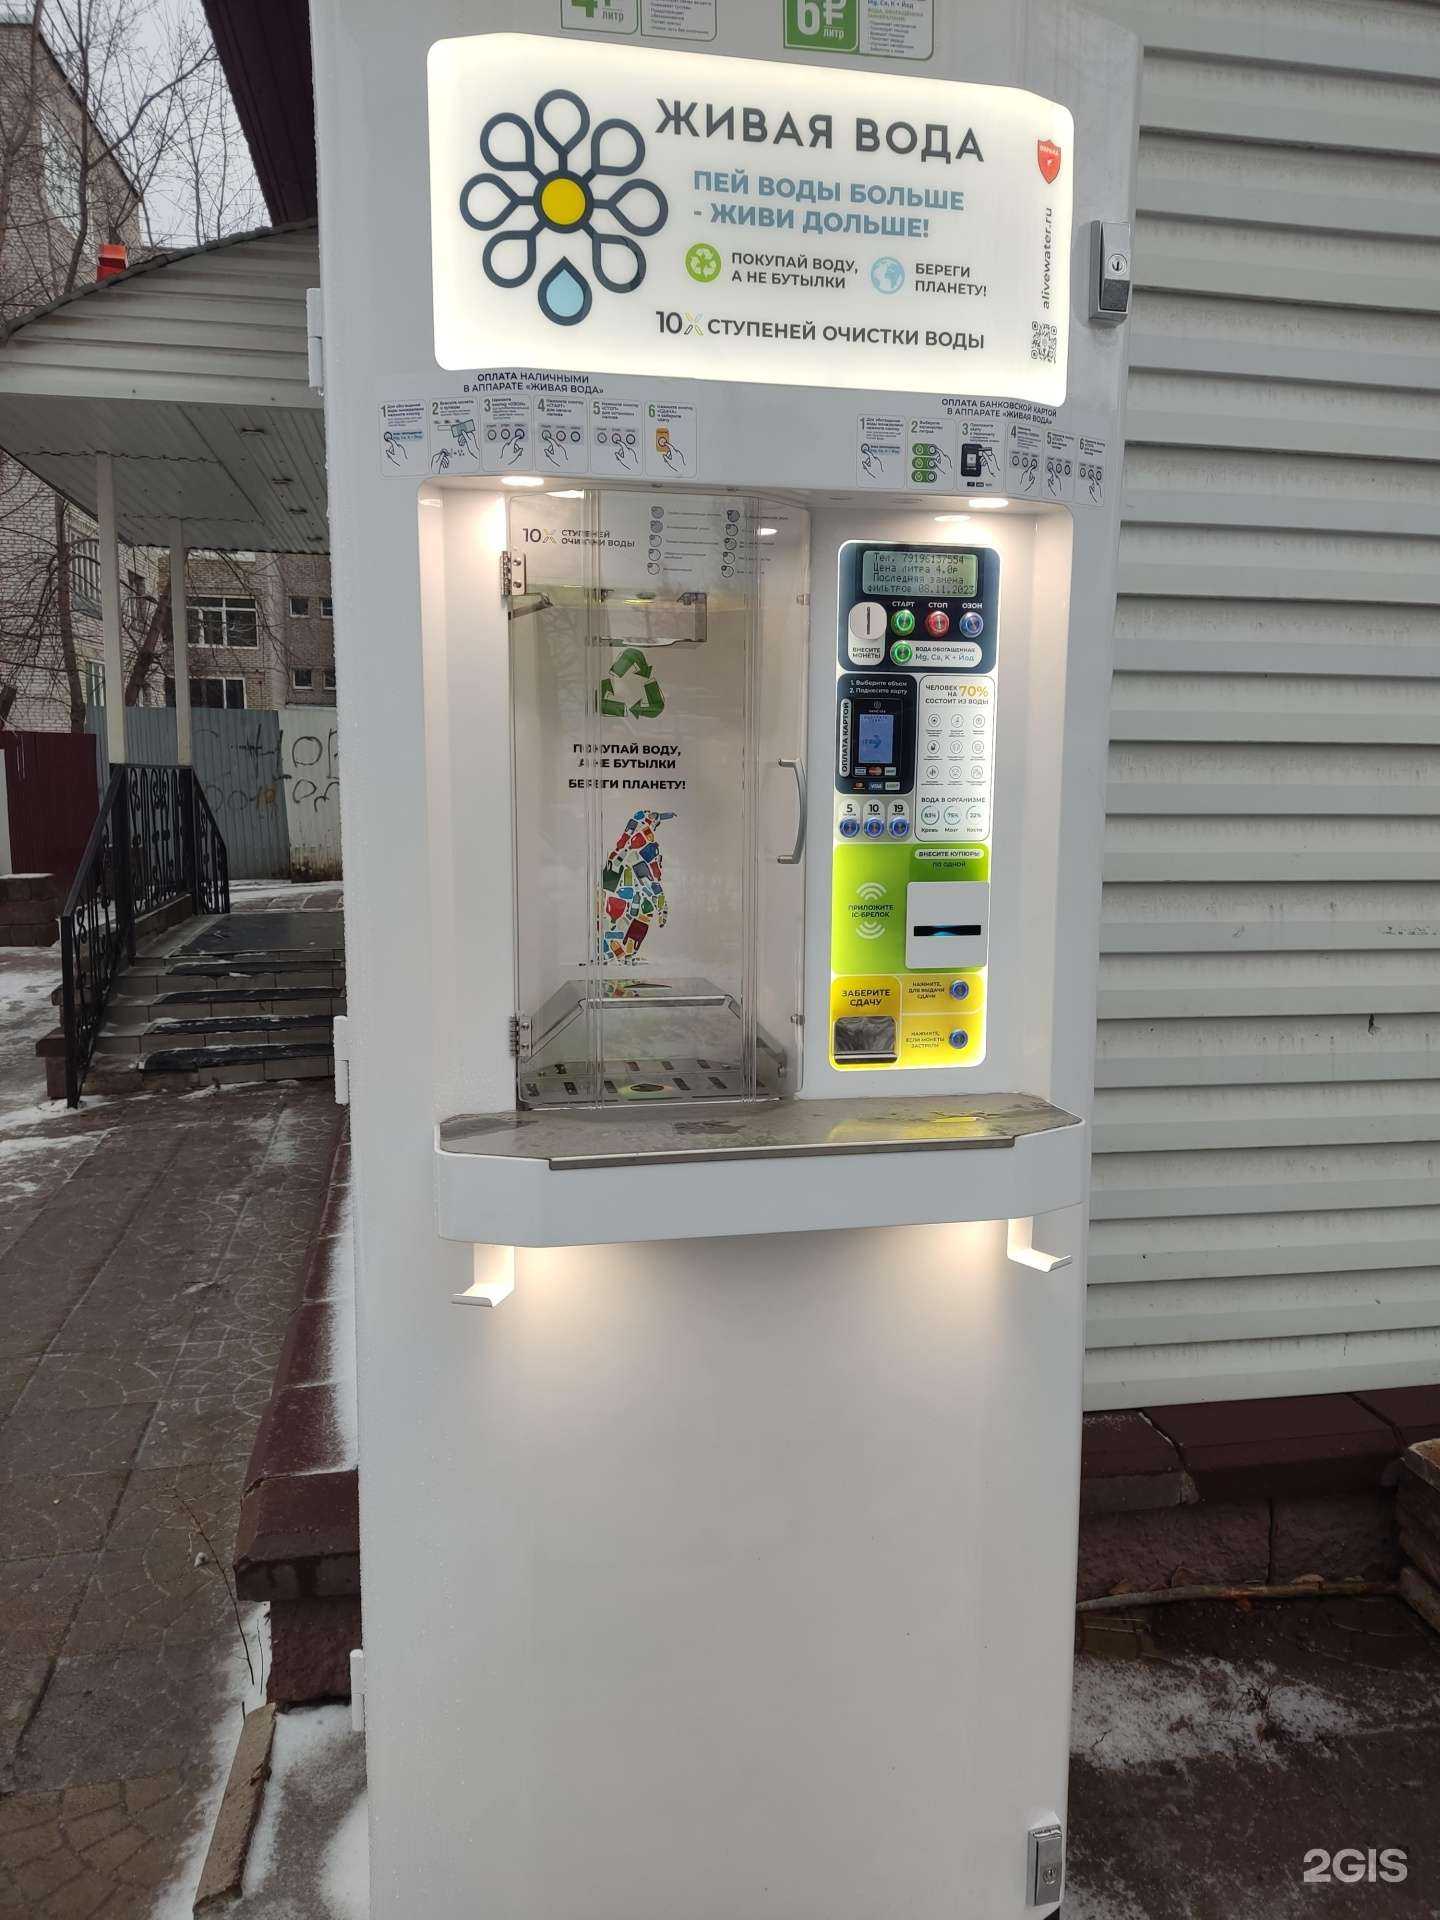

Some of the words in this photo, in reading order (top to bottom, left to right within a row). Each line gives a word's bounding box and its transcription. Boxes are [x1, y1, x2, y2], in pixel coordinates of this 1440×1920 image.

[656, 98, 833, 150] ЖИВАЯ
[855, 115, 984, 163] ВОДА
[692, 170, 752, 196] ПЕЙ
[758, 176, 842, 204] ВОДЫ
[849, 181, 965, 212] БОЛЬШЕ
[710, 203, 796, 231] ЖИВИ
[802, 208, 929, 238] ДОЛЬШЕ!
[731, 251, 808, 273] ПОКУПАЙ
[812, 257, 859, 276] ВОДУ,
[1041, 207, 1053, 310] alivewater.ru
[915, 261, 971, 279] БЕРЕГИ
[731, 272, 741, 284] А
[746, 272, 767, 286] НЕ
[771, 273, 846, 291] БУТЫЛКИ
[915, 279, 987, 298] ПЛАНЕТУ!
[707, 316, 817, 343] СТУПЕНЕЙ
[822, 321, 919, 347] ОЧИСТКИ
[925, 327, 985, 350] ВОДЫ
[477, 372, 517, 382] ОПЛАТА
[521, 372, 589, 383] НАЛИЧНЫМИ
[463, 384, 470, 392] В
[472, 382, 523, 392] АППАРАТЕ
[526, 382, 568, 393] «ЖИВАЯ
[570, 384, 604, 394] ВОДА»
[381, 404, 386, 417] 1
[432, 401, 439, 415] 2
[484, 398, 491, 412] 3
[537, 397, 545, 412] 4
[593, 401, 601, 415] 5
[648, 404, 656, 418] 6
[941, 398, 977, 407] ОПЛАТА
[980, 400, 1032, 414] БАНКОВСКОЙ
[1033, 408, 1057, 418] КАРТОЙ
[947, 407, 953, 415] В
[955, 408, 1000, 417] АППАРАТЕ
[1002, 410, 1032, 421] «ЖИВАЯ
[911, 420, 918, 433] 2
[962, 422, 969, 435] 3
[1010, 425, 1017, 439] 4
[1047, 432, 1052, 445] 5
[608, 539, 635, 548] ВОДЫ
[873, 562, 897, 573] Цена
[873, 572, 925, 583] Последняя
[929, 576, 964, 584] замена
[959, 685, 989, 697] 70%
[643, 745, 682, 756] ВОДУ,
[614, 758, 676, 769] БУТЫЛКИ
[622, 779, 686, 790] ПЛАНЕТУ!
[846, 803, 853, 813] 5
[868, 803, 880, 813] 10
[893, 804, 904, 813] 19
[842, 988, 892, 997] ЗАБЕРИТЕ
[849, 998, 882, 1007] СДАЧУ
